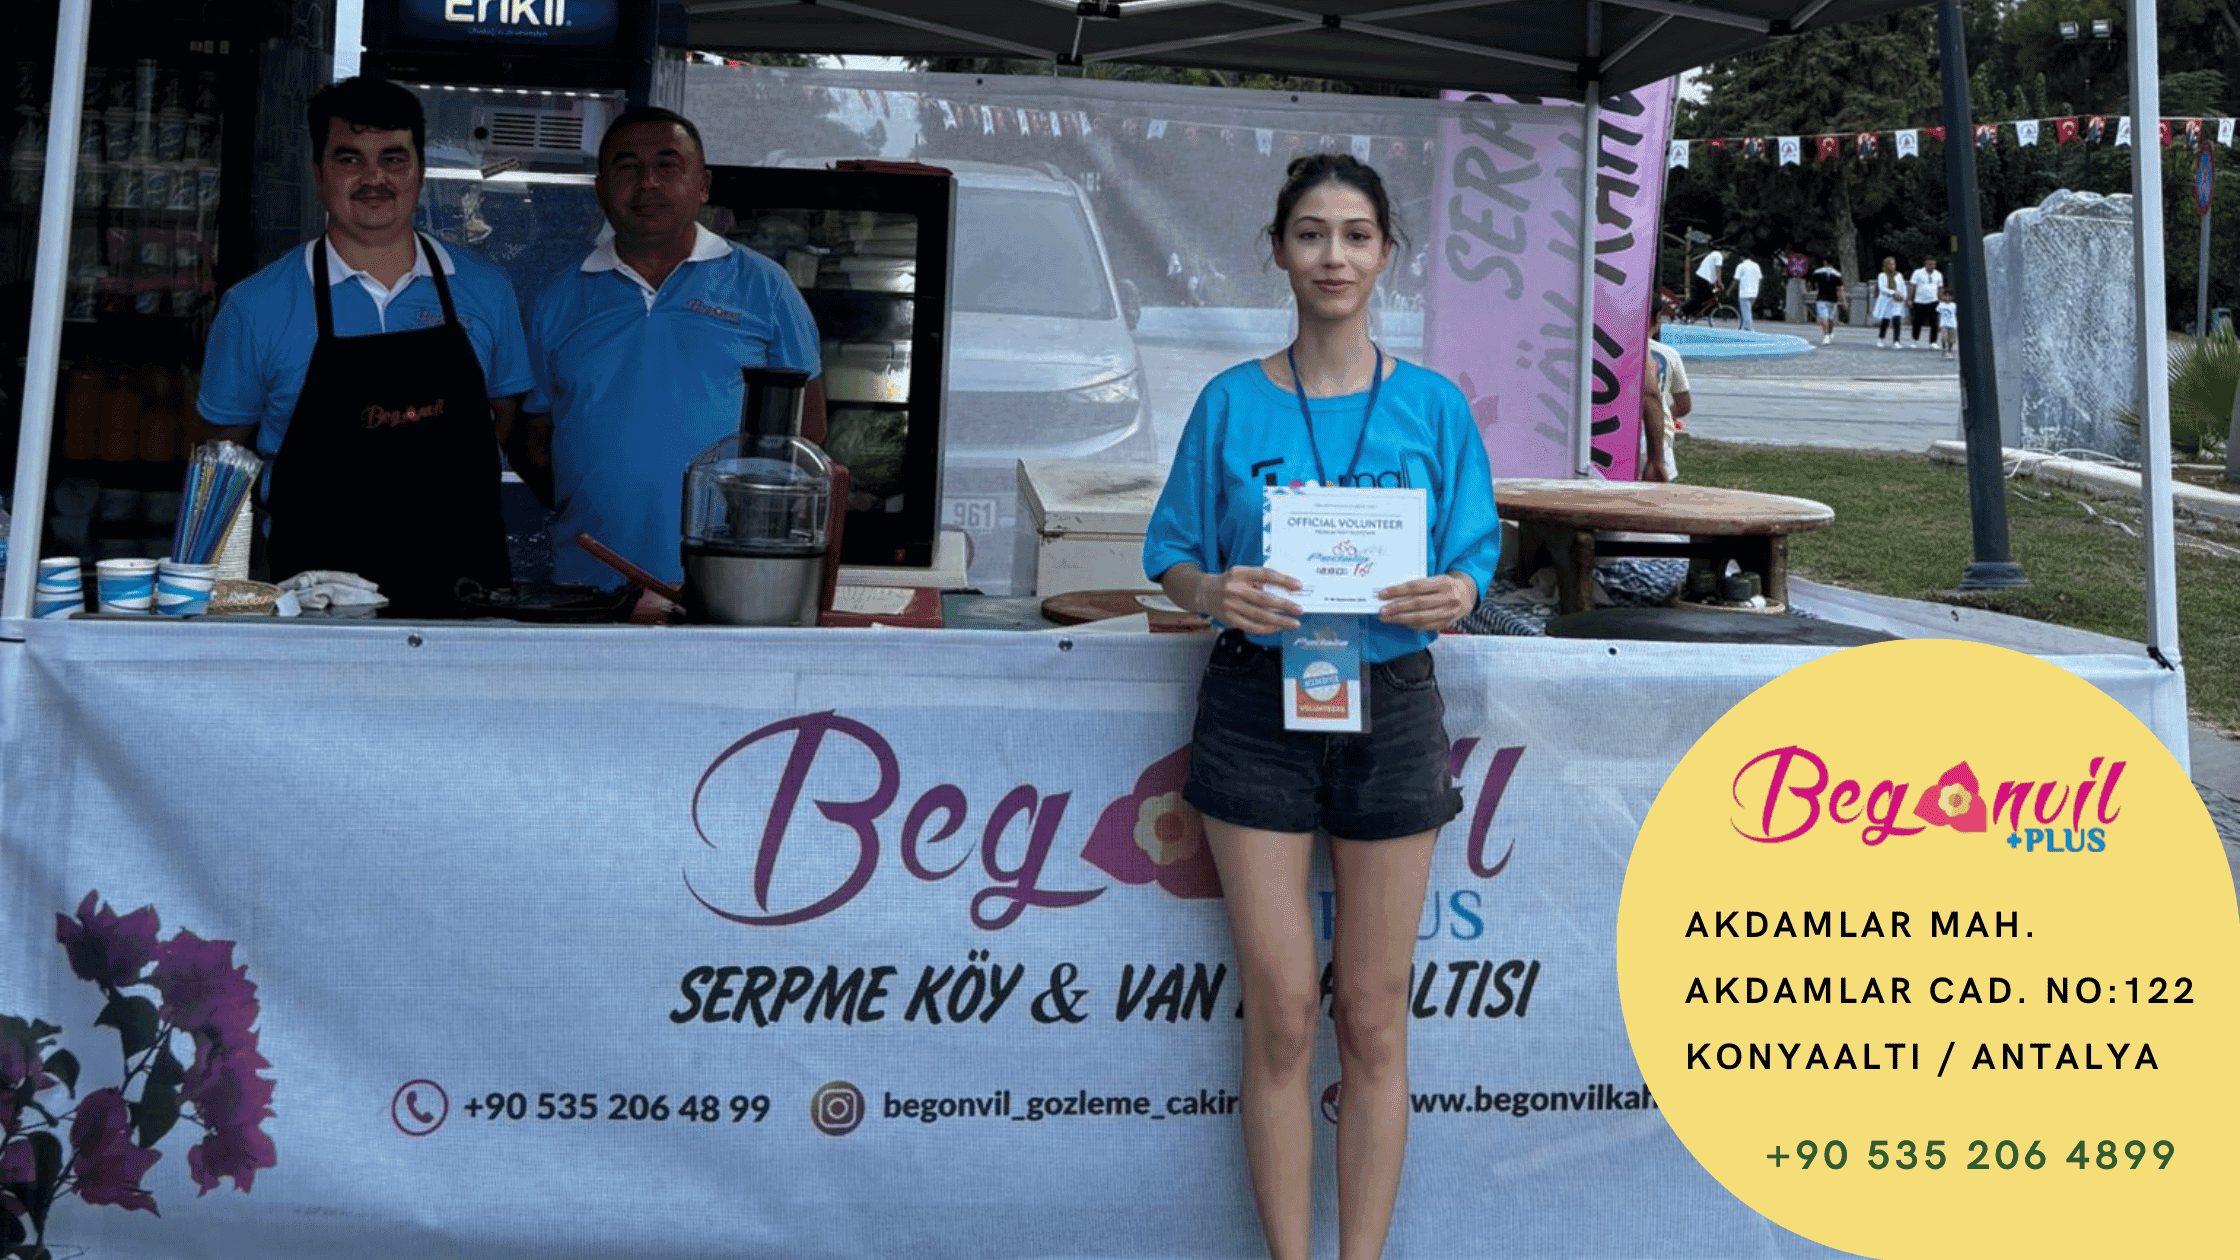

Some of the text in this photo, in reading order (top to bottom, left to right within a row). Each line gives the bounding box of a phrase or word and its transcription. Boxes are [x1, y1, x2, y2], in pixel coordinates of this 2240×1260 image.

[953, 502, 991, 527] 961
[1287, 516, 1404, 530] OFFICIAL VOLUNTEER
[670, 962, 898, 1027] SERPME
[904, 949, 1024, 1026] KÖY
[1030, 962, 1088, 1025] &
[1115, 962, 1227, 1024] VAN
[464, 1093, 770, 1122] +90 535 206 48 99
[884, 1089, 1242, 1123] begonvil_gozleme_cakir
